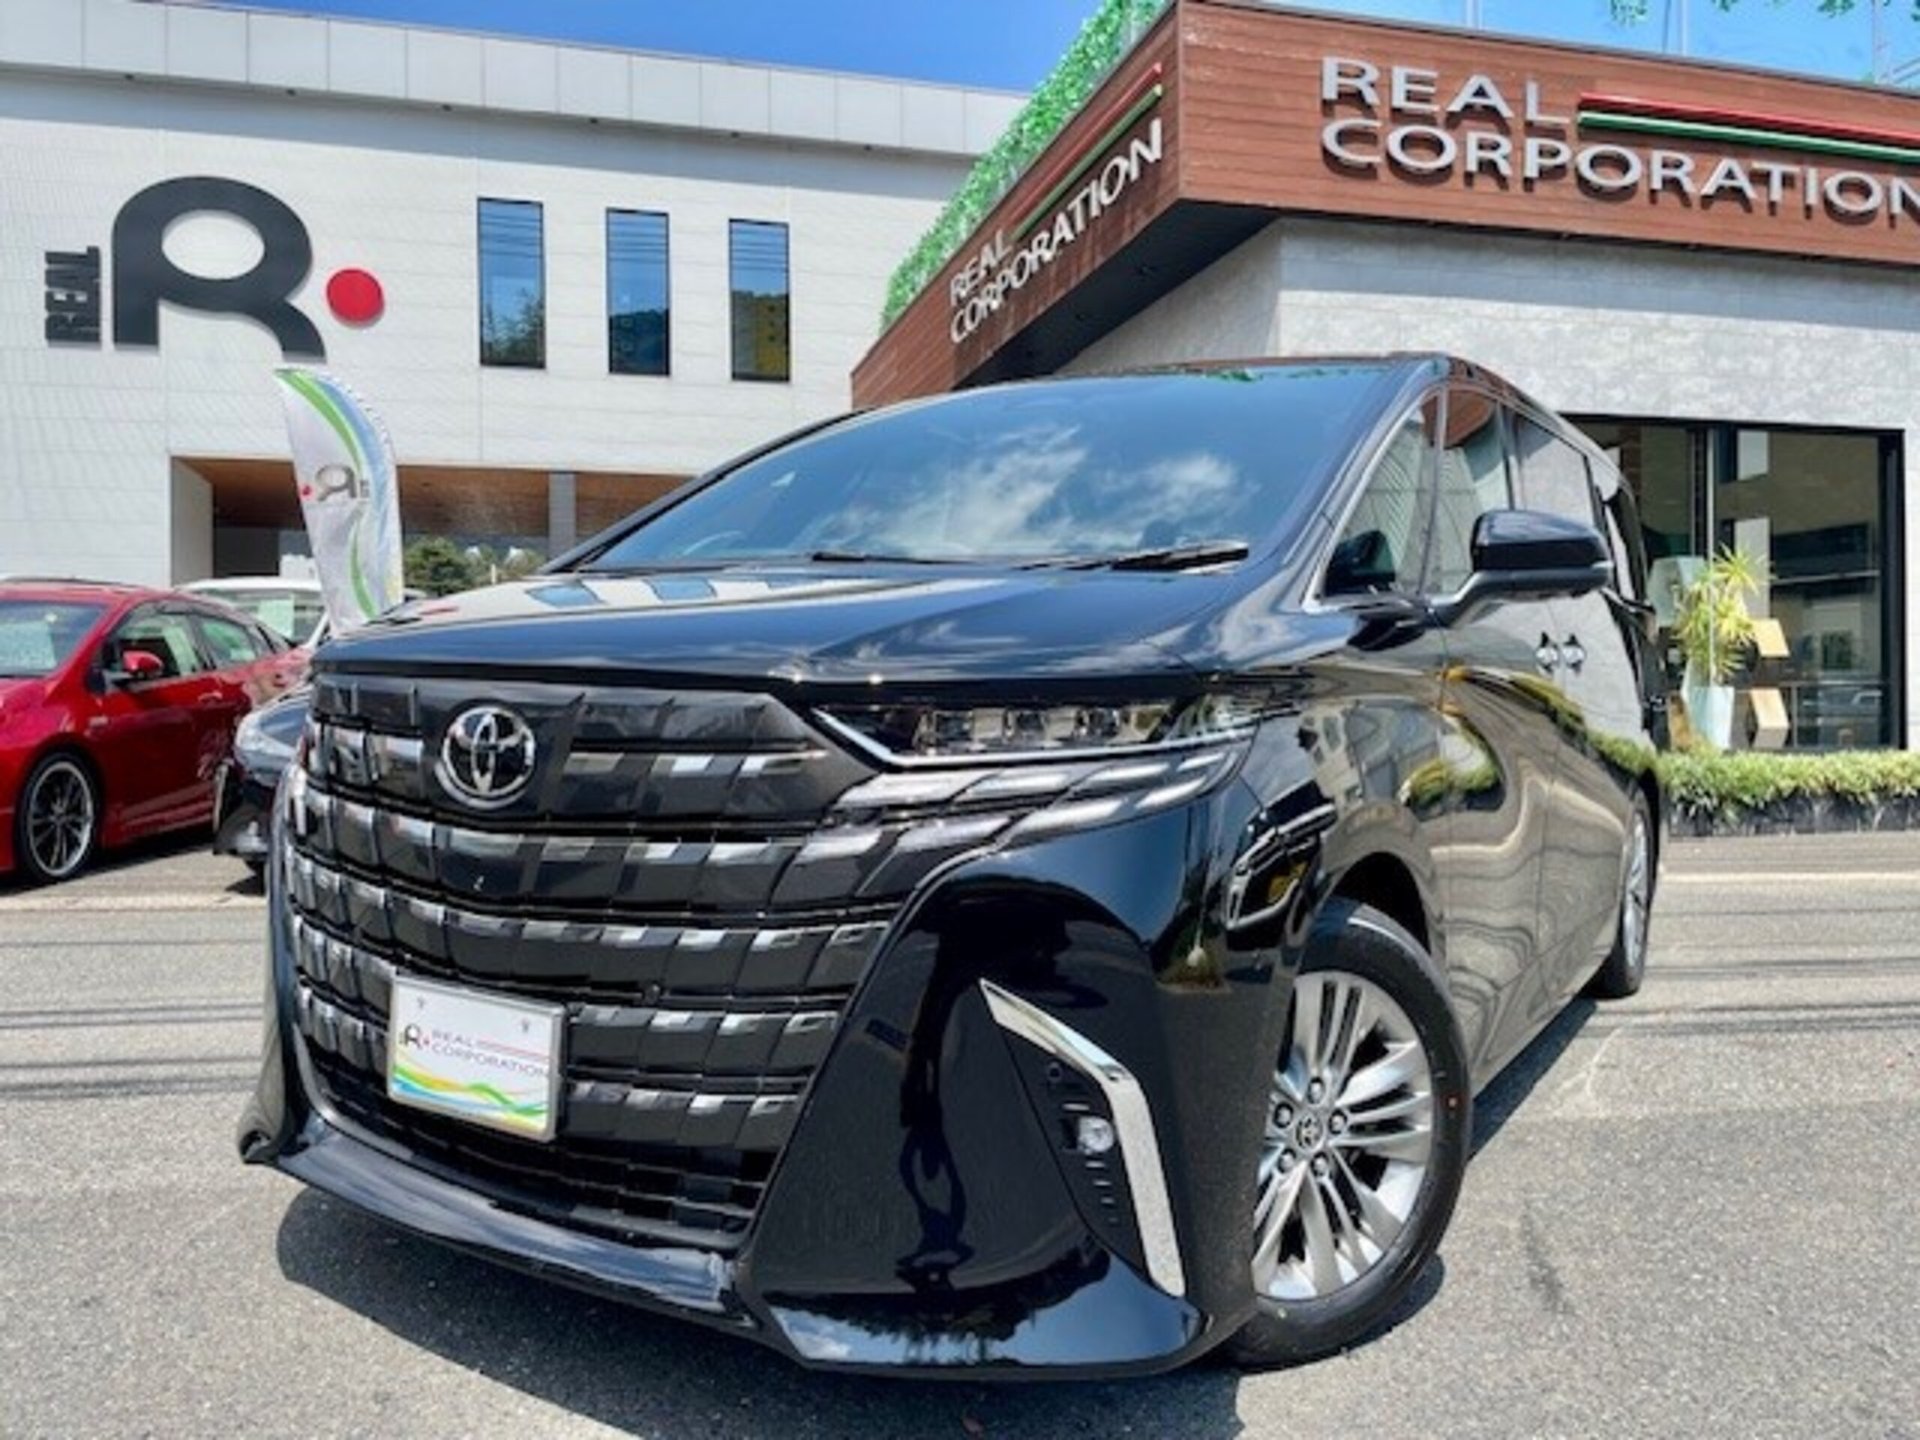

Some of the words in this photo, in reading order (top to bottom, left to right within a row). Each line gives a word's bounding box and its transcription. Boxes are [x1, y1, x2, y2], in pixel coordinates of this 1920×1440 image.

[1321, 56, 1570, 125] REAL
[1321, 118, 1920, 216] CORPORATION
[950, 229, 1013, 306] REAL
[951, 117, 1163, 344] CORPORATION
[432, 1029, 473, 1048] REAL
